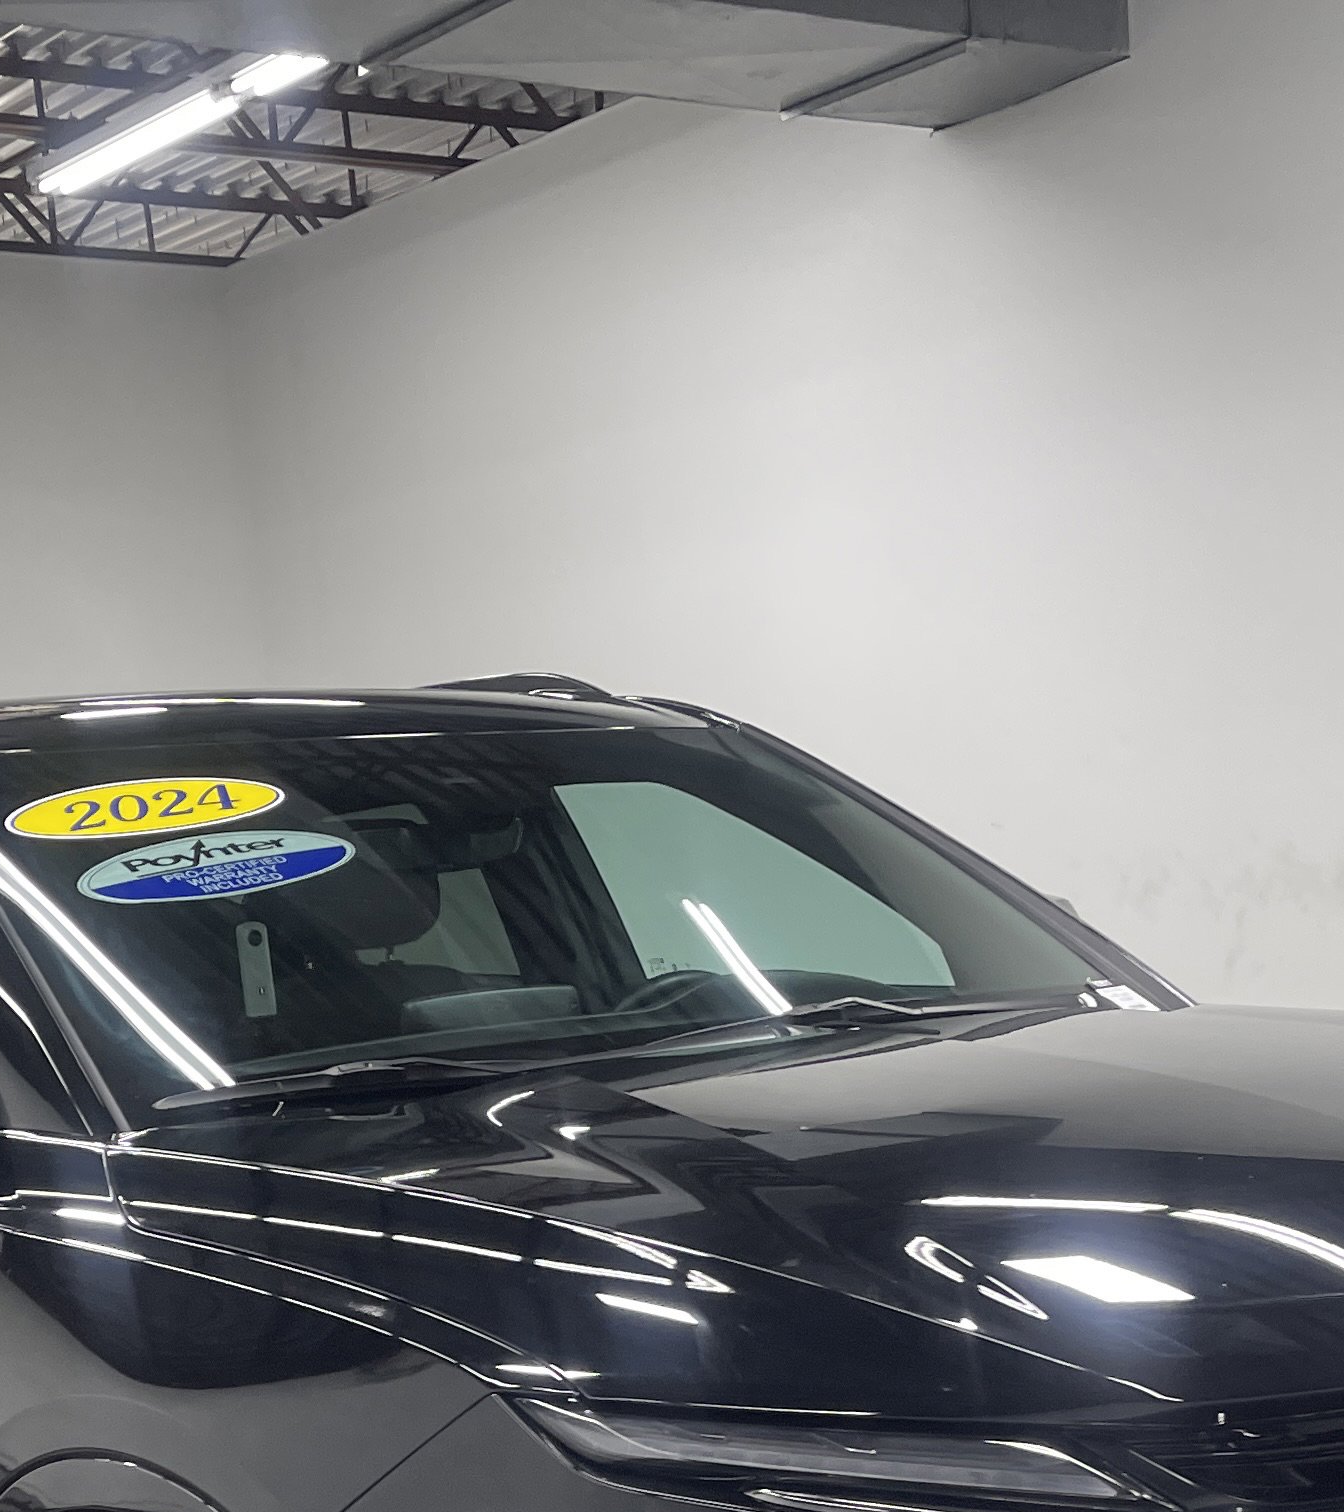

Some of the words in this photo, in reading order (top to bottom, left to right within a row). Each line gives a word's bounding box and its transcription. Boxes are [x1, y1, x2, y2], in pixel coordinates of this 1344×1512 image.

[64, 783, 241, 831] 2024
[121, 838, 285, 873] Poynter
[161, 855, 288, 883] PRO-CERTIFIED
[186, 865, 278, 887] WARRANTY
[199, 872, 284, 894] INCLUDED
